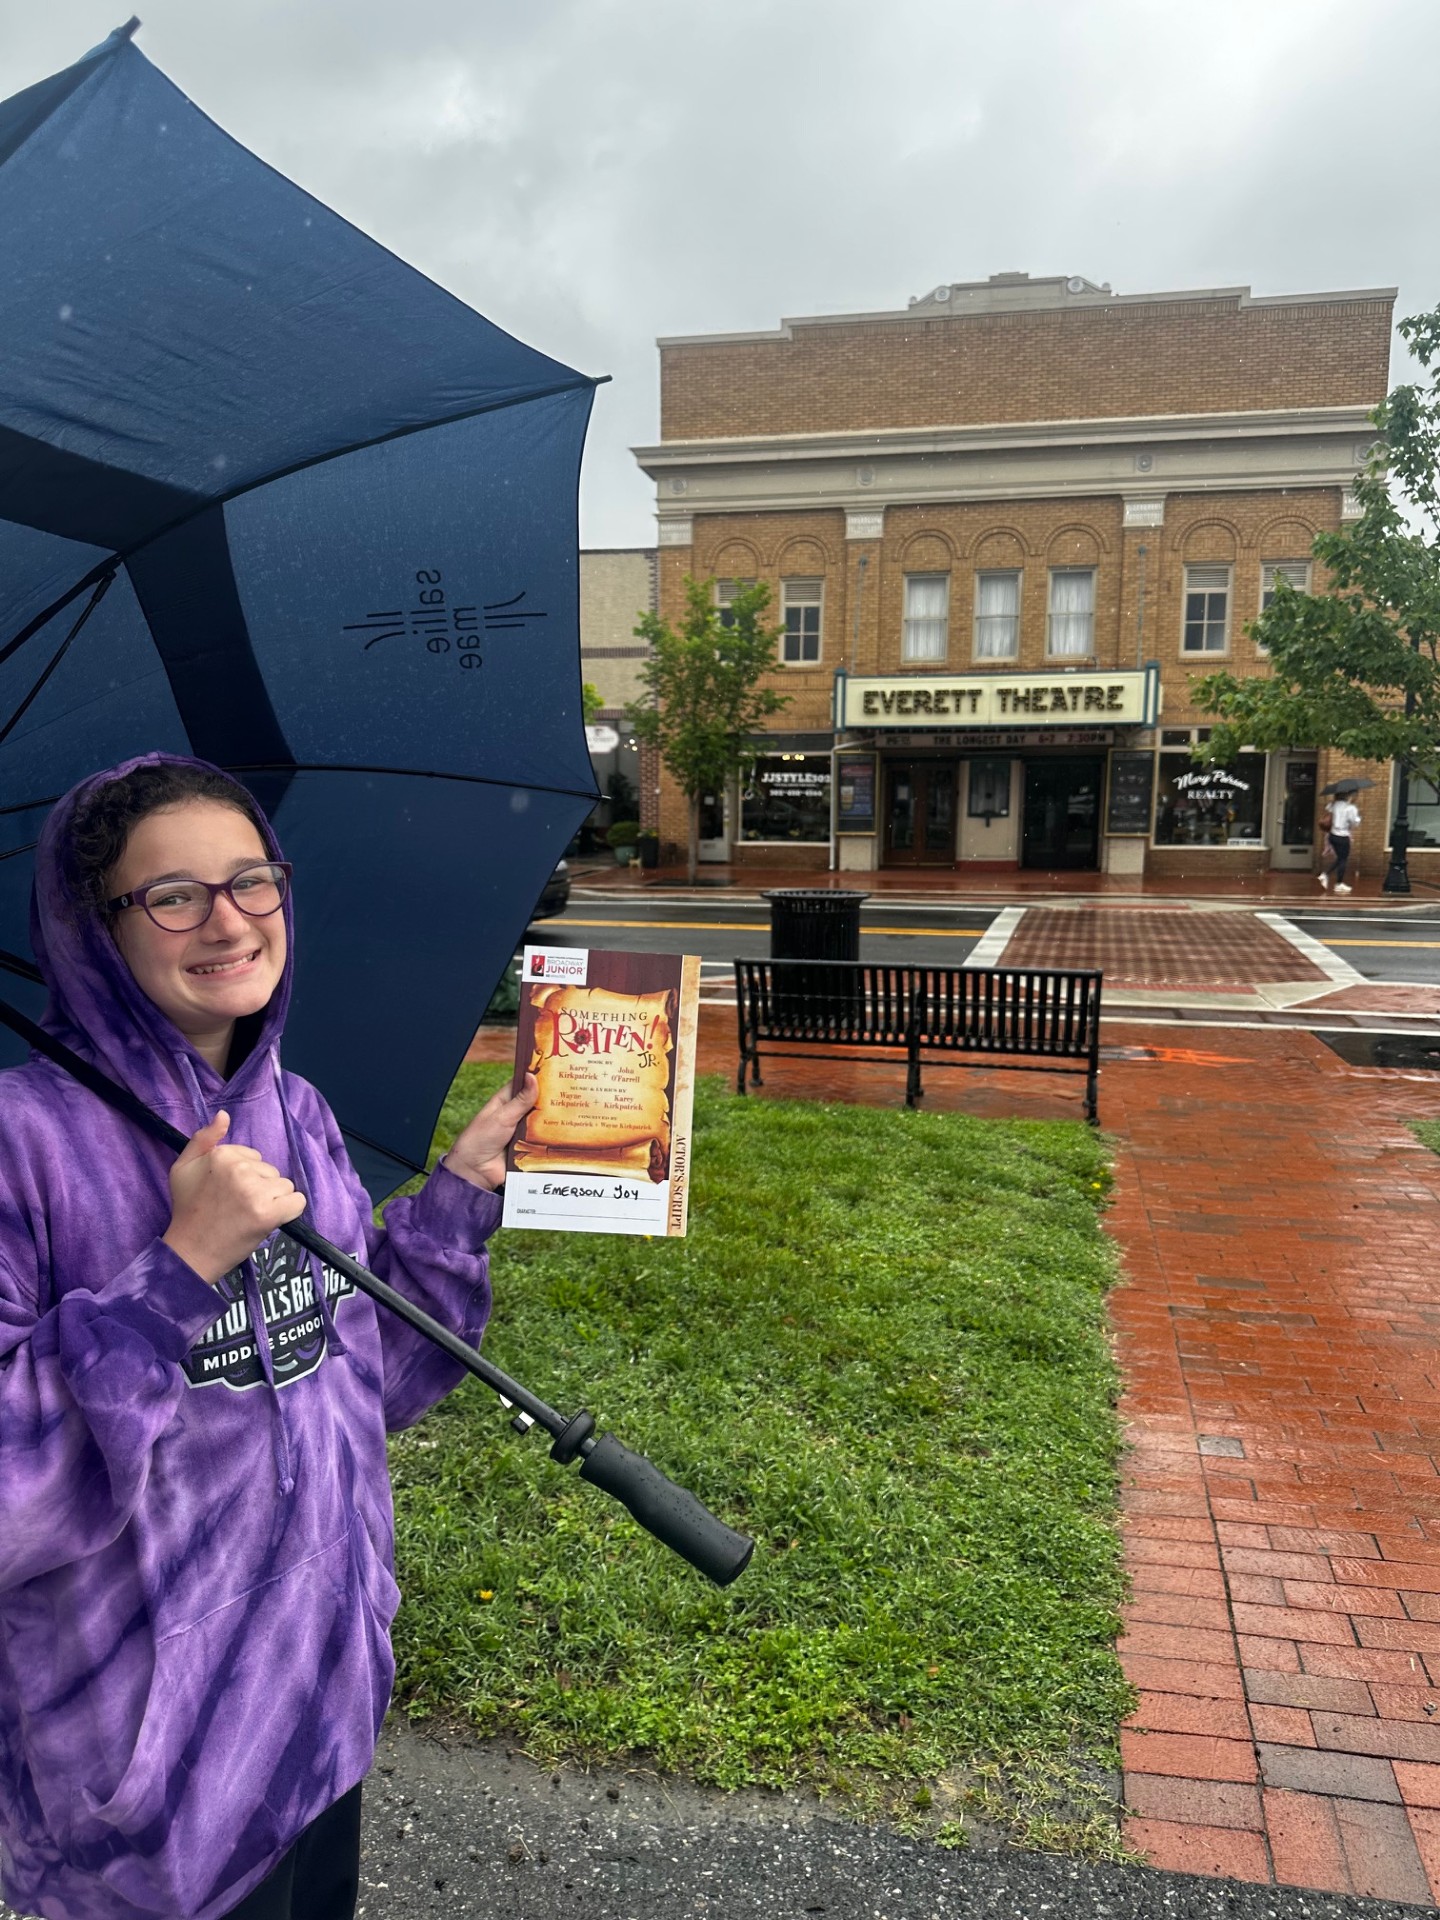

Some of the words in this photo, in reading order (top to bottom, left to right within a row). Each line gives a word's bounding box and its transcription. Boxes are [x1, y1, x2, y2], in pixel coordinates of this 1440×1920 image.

[863, 689, 982, 714] EVERETT
[996, 685, 1124, 713] THEATRE
[934, 736, 950, 746] THE
[956, 735, 1001, 746] LONGEST
[1006, 734, 1026, 744] DAY
[1172, 772, 1212, 790] Mary
[1187, 789, 1235, 800] REALTY
[546, 966, 583, 975] JUNIOR
[561, 1007, 648, 1022] SOMETHING
[569, 1064, 588, 1072] Karey
[558, 1071, 598, 1080] Kirkpatrick
[611, 1075, 640, 1083] O'Farrell
[560, 1091, 582, 1100] Wayne
[614, 1094, 634, 1103] Karey
[550, 1099, 590, 1109] Kirkpatrick
[604, 1102, 643, 1111] Kirkpatrick
[674, 1134, 686, 1183] ACTOR'S
[542, 1183, 605, 1198] EMERSON
[671, 1185, 684, 1230] SCRIPT
